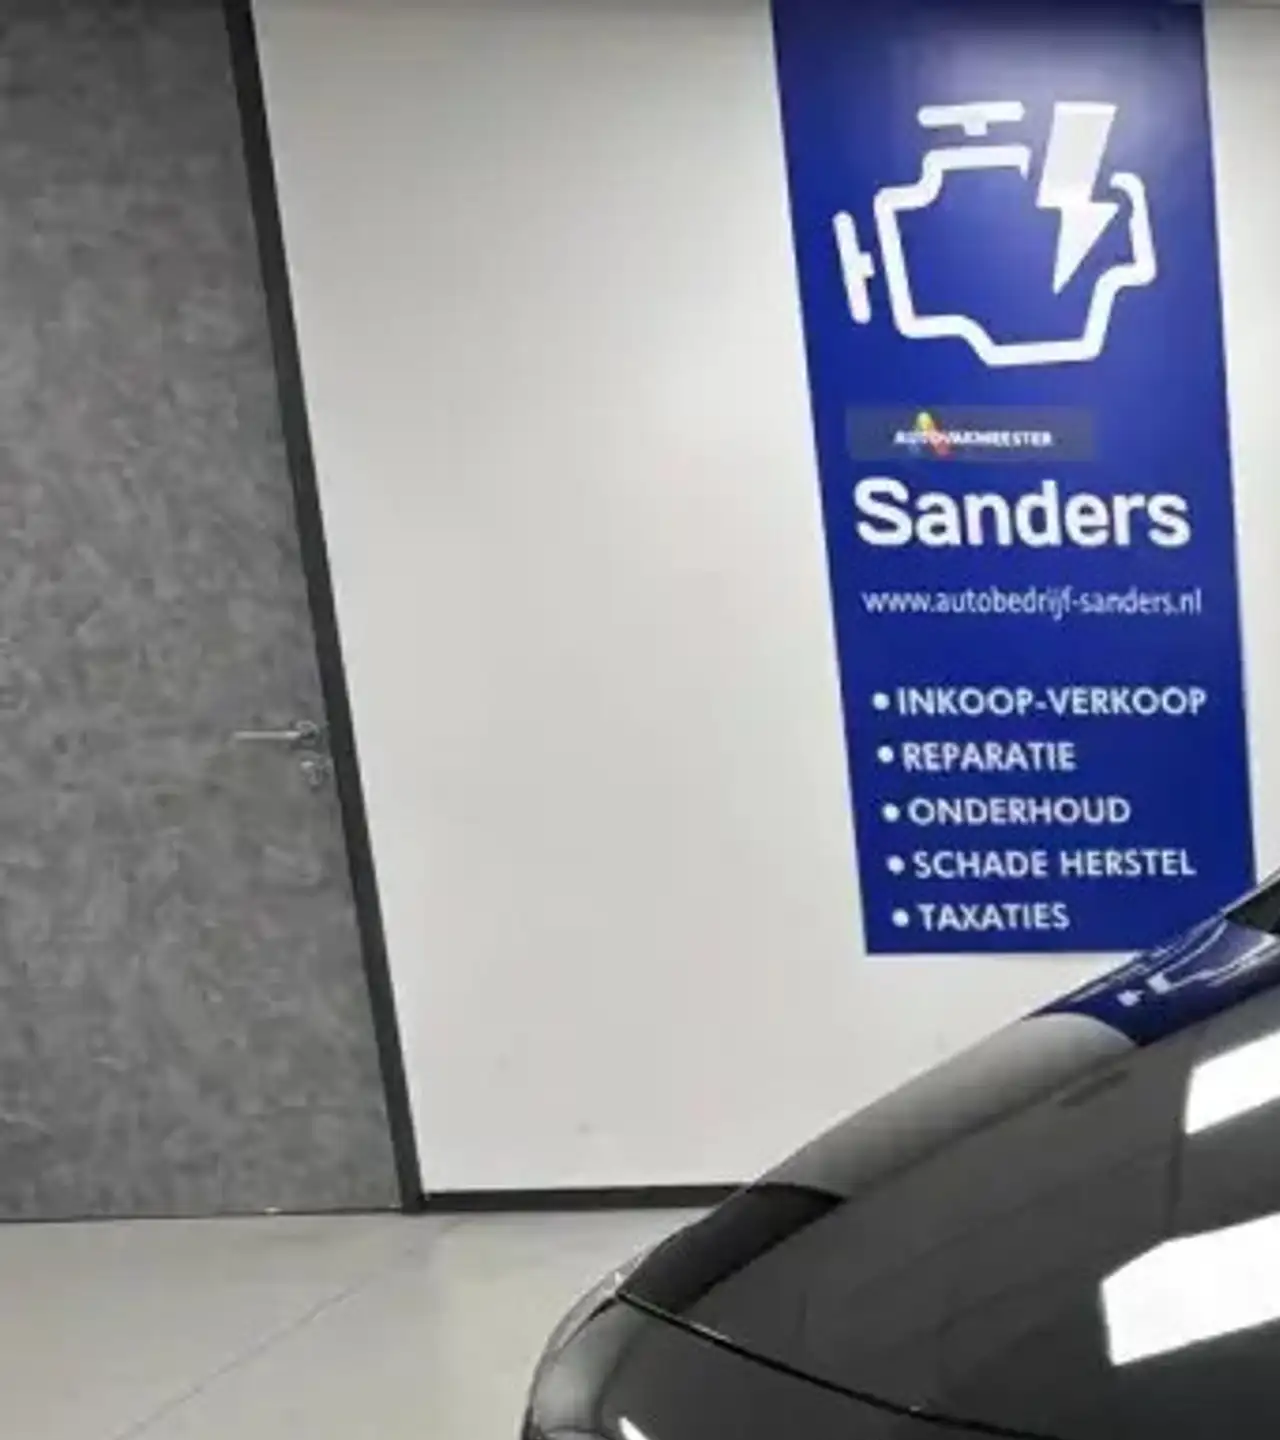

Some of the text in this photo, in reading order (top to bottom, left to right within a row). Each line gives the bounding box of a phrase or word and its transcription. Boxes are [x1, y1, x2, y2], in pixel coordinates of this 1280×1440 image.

[853, 476, 1192, 548] Sanders
[861, 584, 1202, 621] www.autobedrijf-sanders.nl
[898, 687, 1207, 716] INKOOP-VERKOOP
[902, 742, 1077, 772] REPARATIE
[908, 797, 1131, 825] ONDERHOUD
[912, 848, 1196, 879] SCHADE HERSTEL
[918, 903, 1070, 931] TAXATIES
